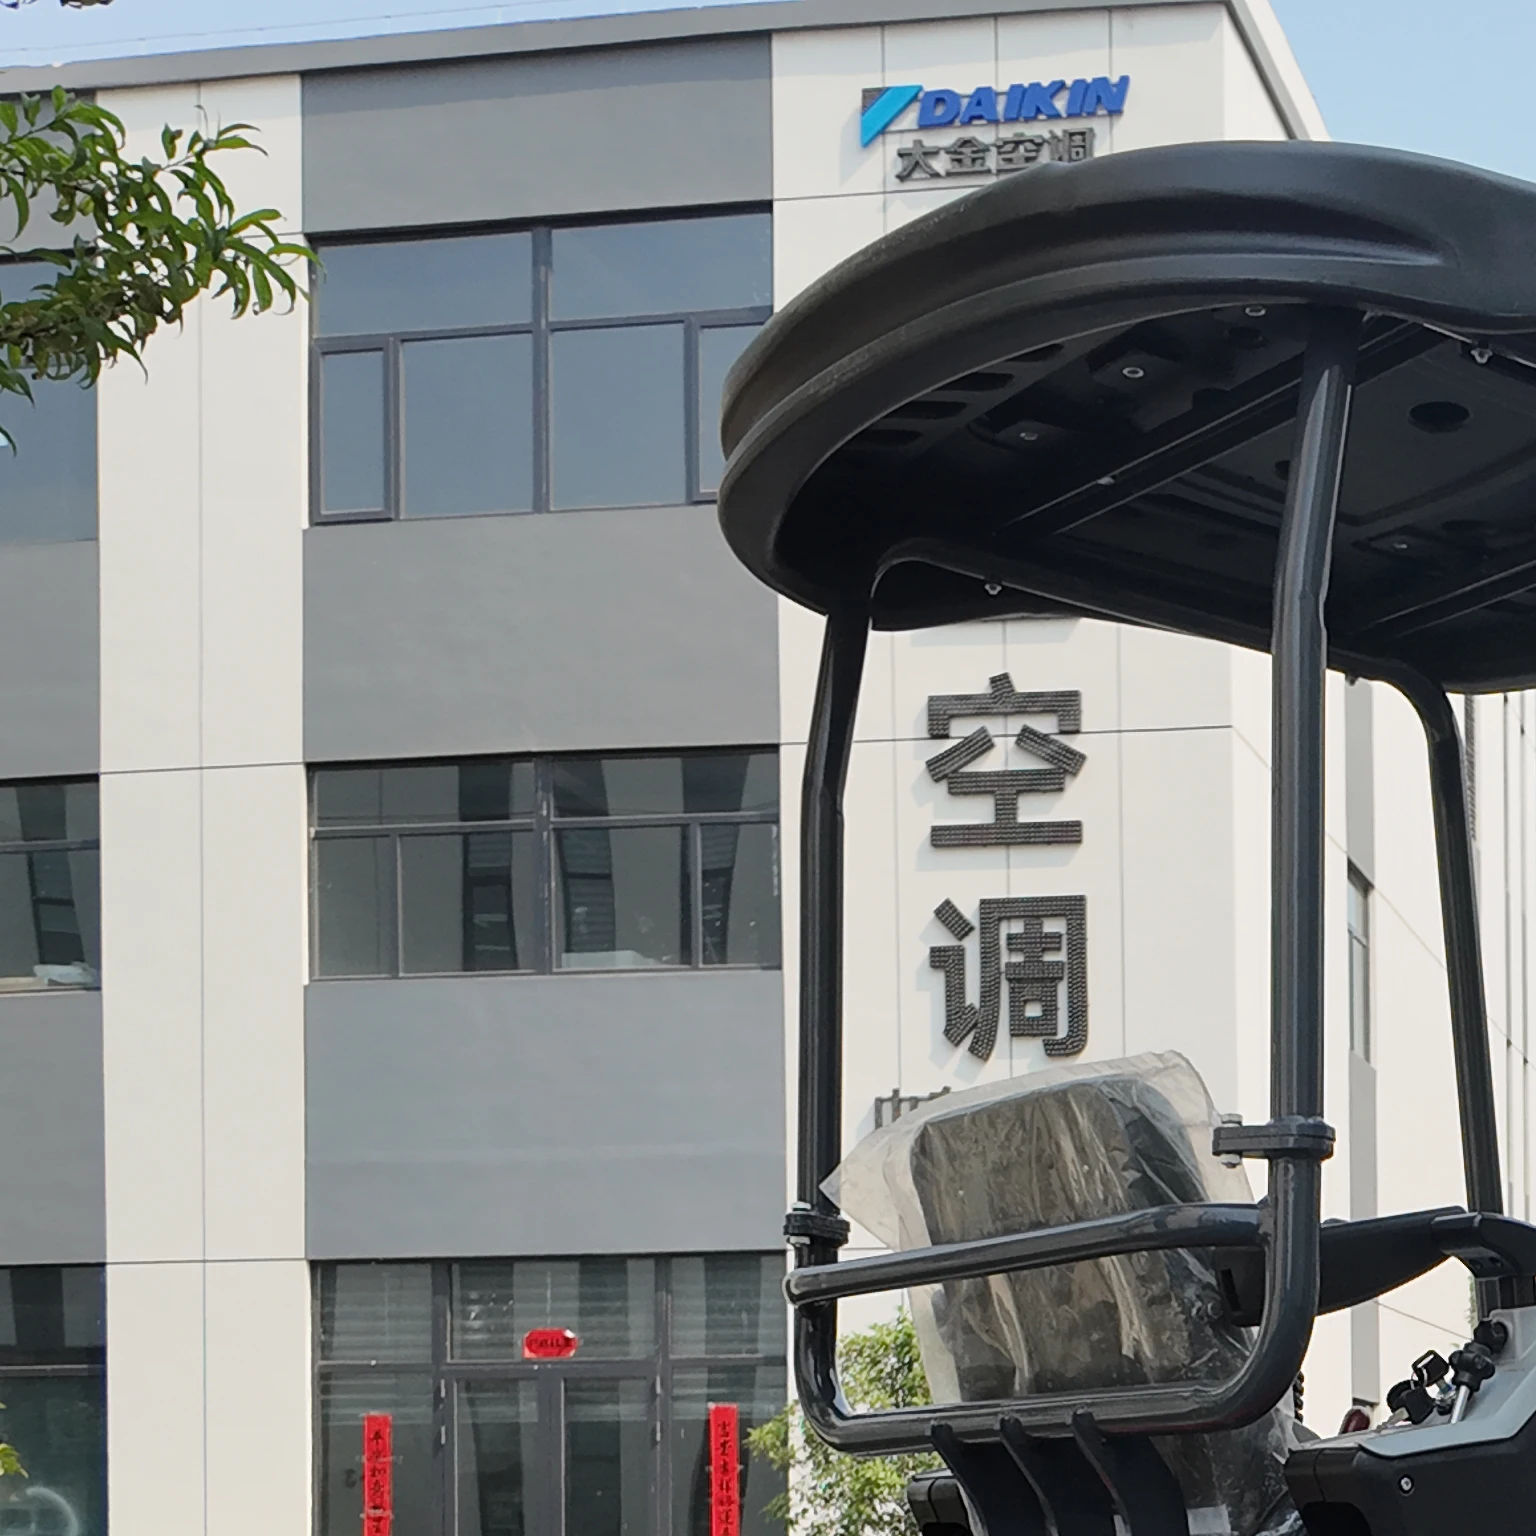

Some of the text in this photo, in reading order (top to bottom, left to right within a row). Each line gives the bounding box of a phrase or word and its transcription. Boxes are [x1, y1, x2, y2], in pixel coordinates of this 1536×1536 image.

[918, 75, 1130, 127] DAIKIN
[895, 127, 1094, 182] 大金空调
[926, 672, 1087, 1061] 空调
